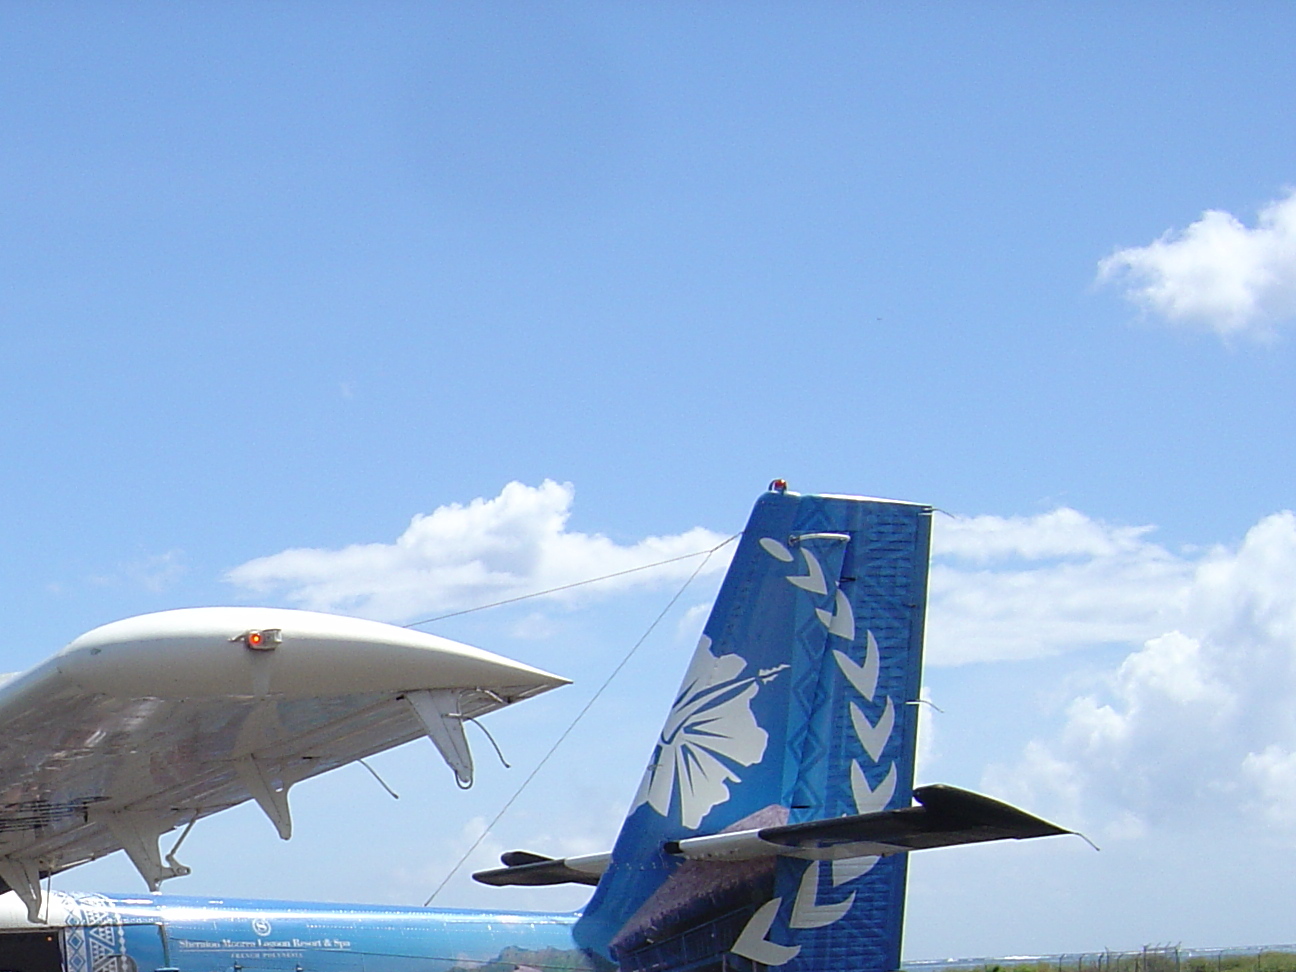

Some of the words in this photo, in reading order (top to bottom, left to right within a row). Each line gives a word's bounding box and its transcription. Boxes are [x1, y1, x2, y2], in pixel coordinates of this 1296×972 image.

[257, 938, 291, 950] Lagoon
[293, 938, 322, 948] Resort
[323, 938, 332, 948] &
[334, 938, 351, 950] Spa
